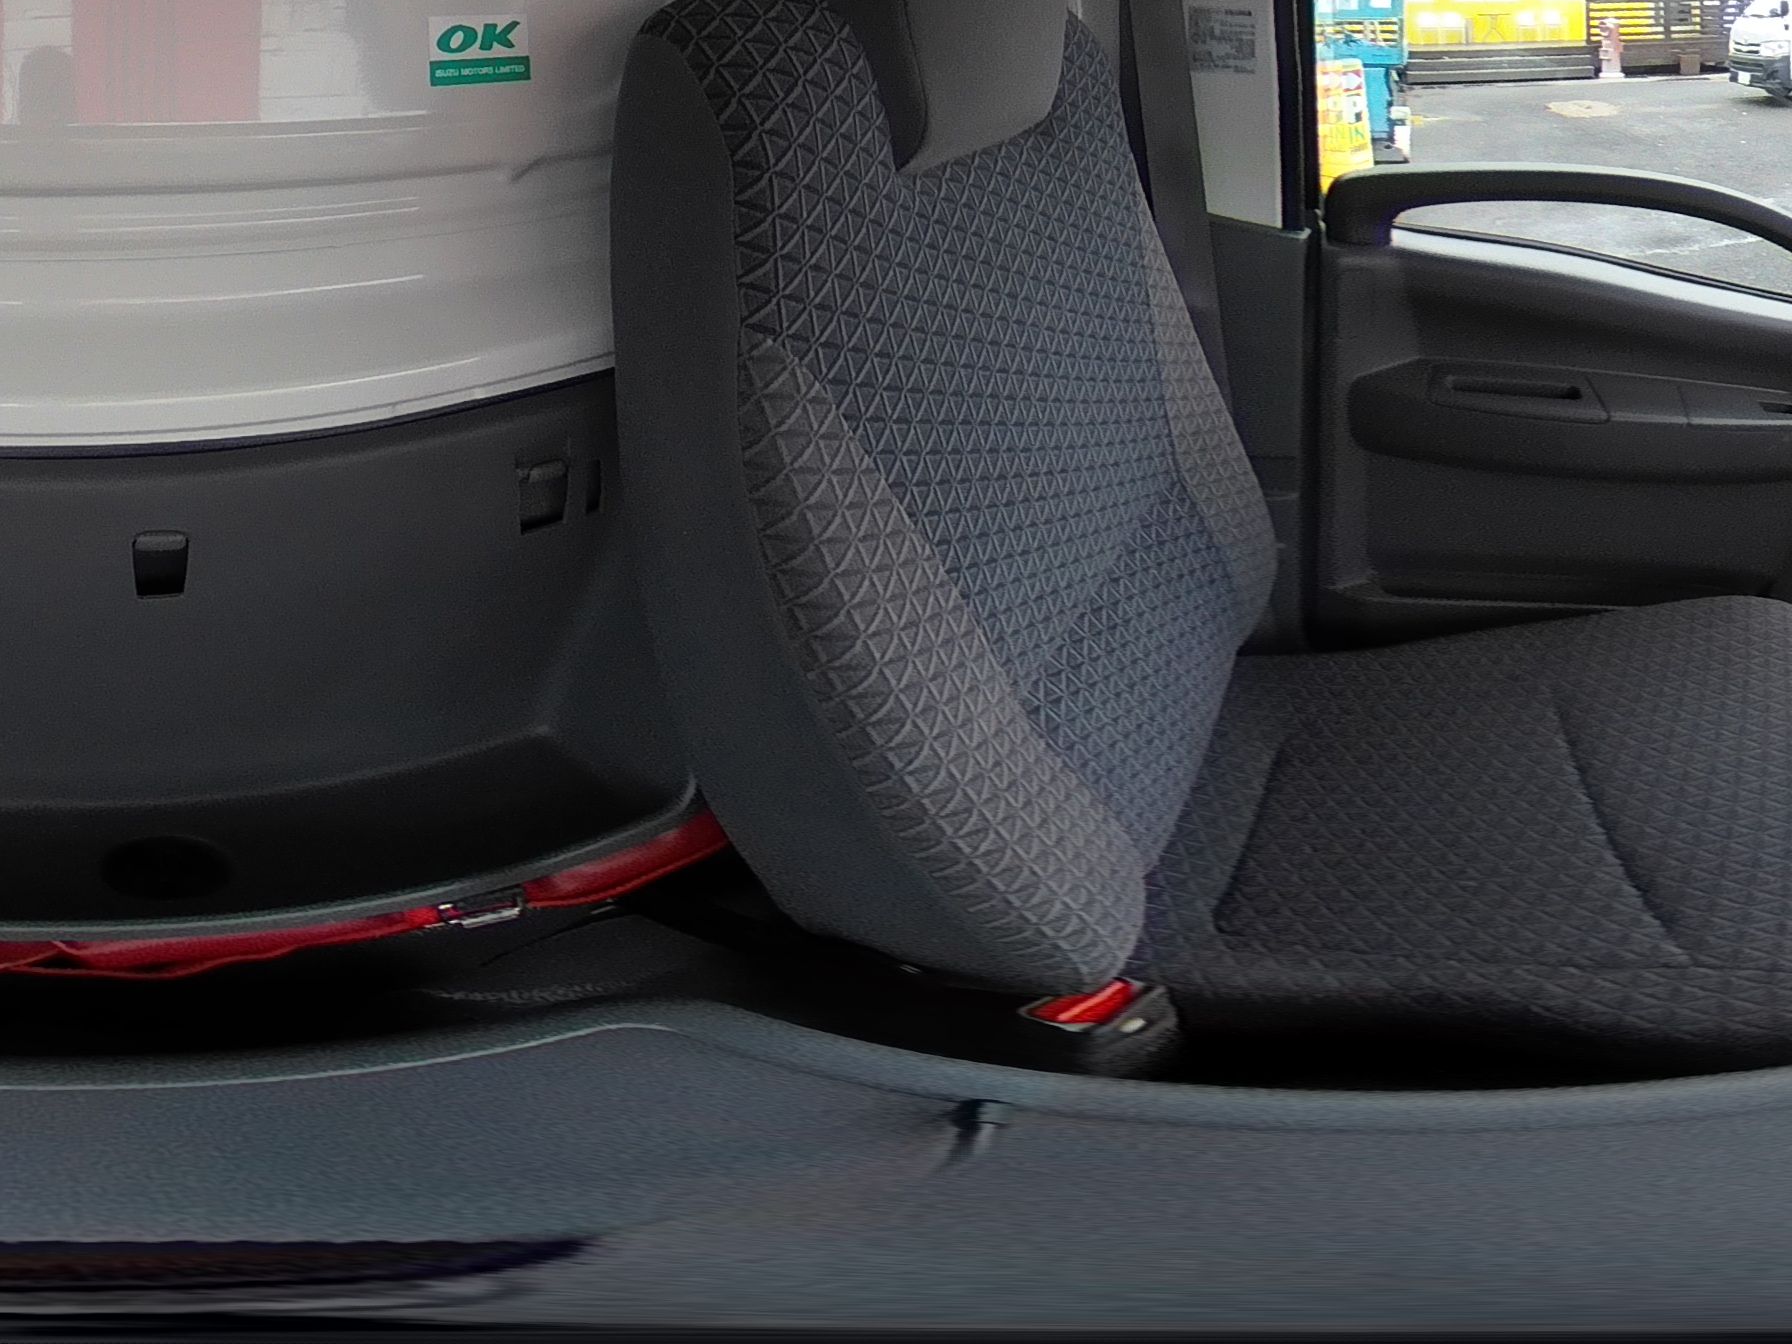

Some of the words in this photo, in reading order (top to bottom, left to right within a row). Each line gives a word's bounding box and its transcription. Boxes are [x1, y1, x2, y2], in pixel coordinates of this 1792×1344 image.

[436, 20, 521, 53] OK
[460, 66, 494, 76] MOTORS
[495, 64, 525, 74] LIMITED
